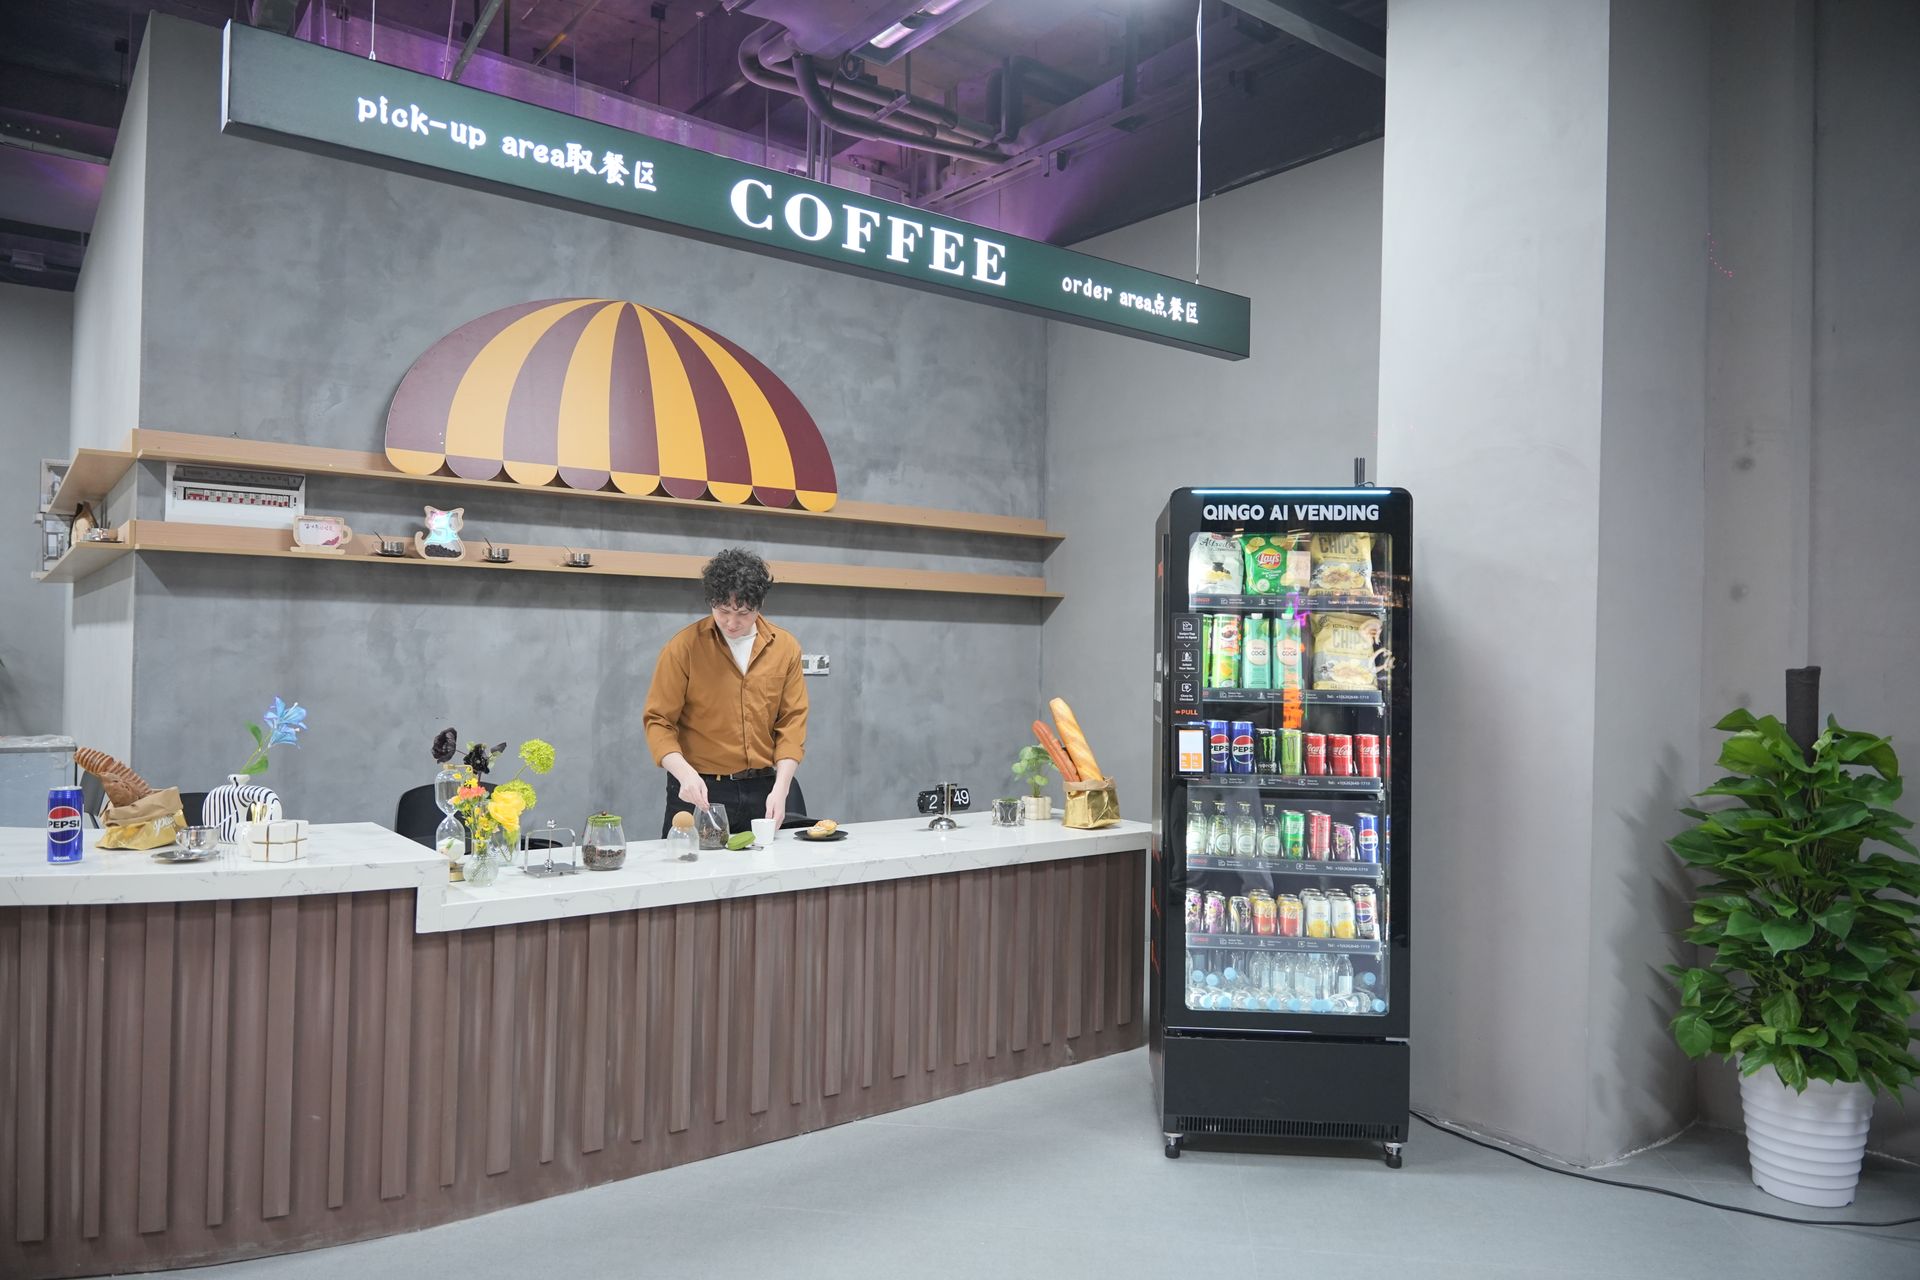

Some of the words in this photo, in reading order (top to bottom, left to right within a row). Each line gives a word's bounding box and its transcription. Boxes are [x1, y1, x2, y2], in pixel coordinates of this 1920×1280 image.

[356, 95, 487, 151] pick-up
[730, 178, 1008, 287] COFFEE
[1061, 276, 1113, 302] order
[1202, 504, 1265, 521] QINGO
[1269, 504, 1289, 521] AI
[1294, 504, 1380, 521] VENDING
[1319, 535, 1359, 555] CHIPS
[929, 794, 938, 810] 2
[953, 790, 970, 805] 49
[49, 819, 80, 829] PEPSI
